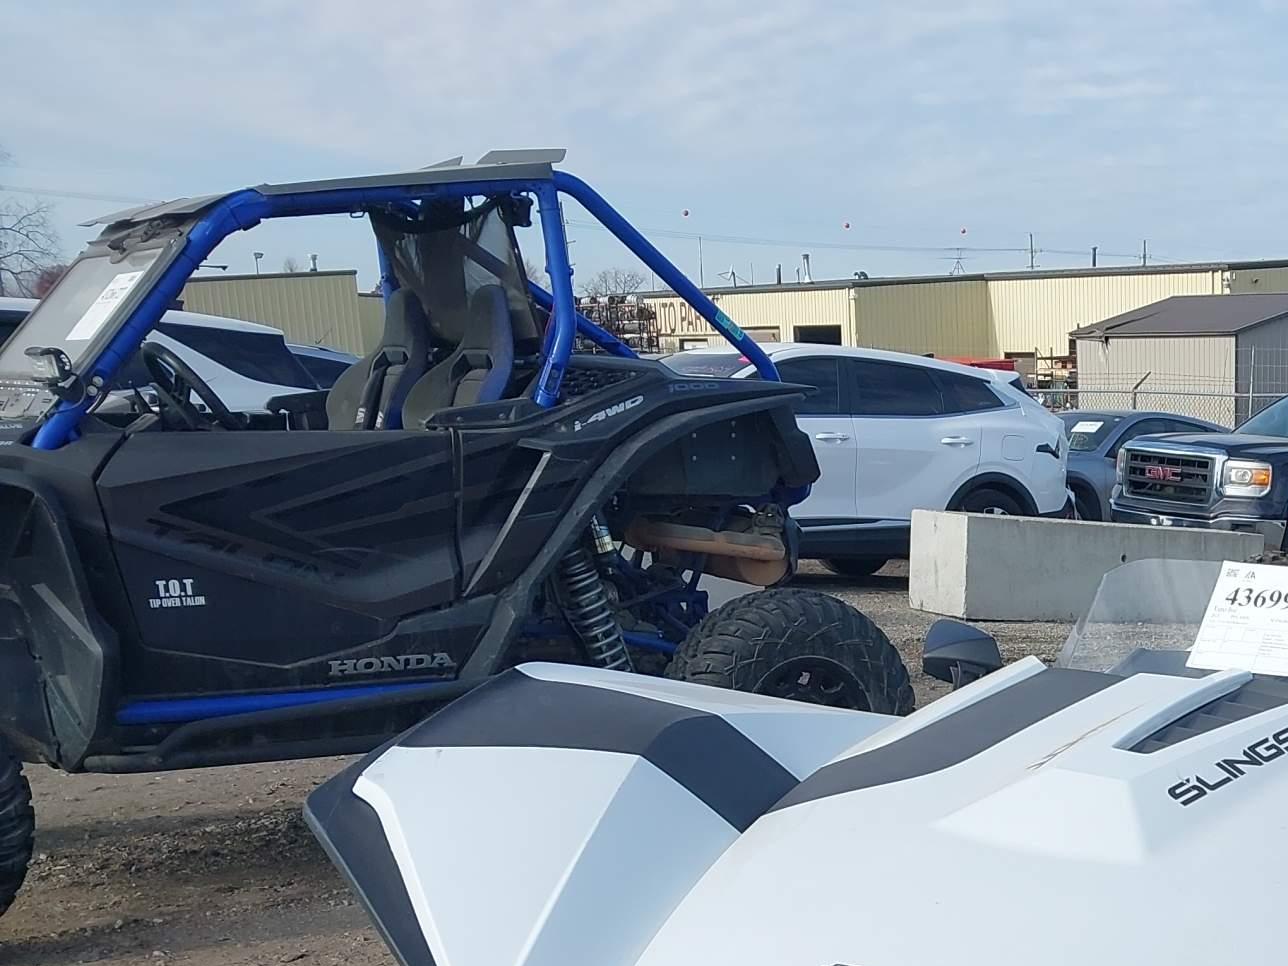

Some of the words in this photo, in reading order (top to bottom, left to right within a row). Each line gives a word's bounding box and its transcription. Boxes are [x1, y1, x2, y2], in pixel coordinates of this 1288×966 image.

[575, 395, 644, 432] i-4WD
[1145, 465, 1182, 481] GMC
[155, 578, 194, 597] T.O.T
[161, 597, 181, 607] OVER
[328, 652, 457, 677] HONDA
